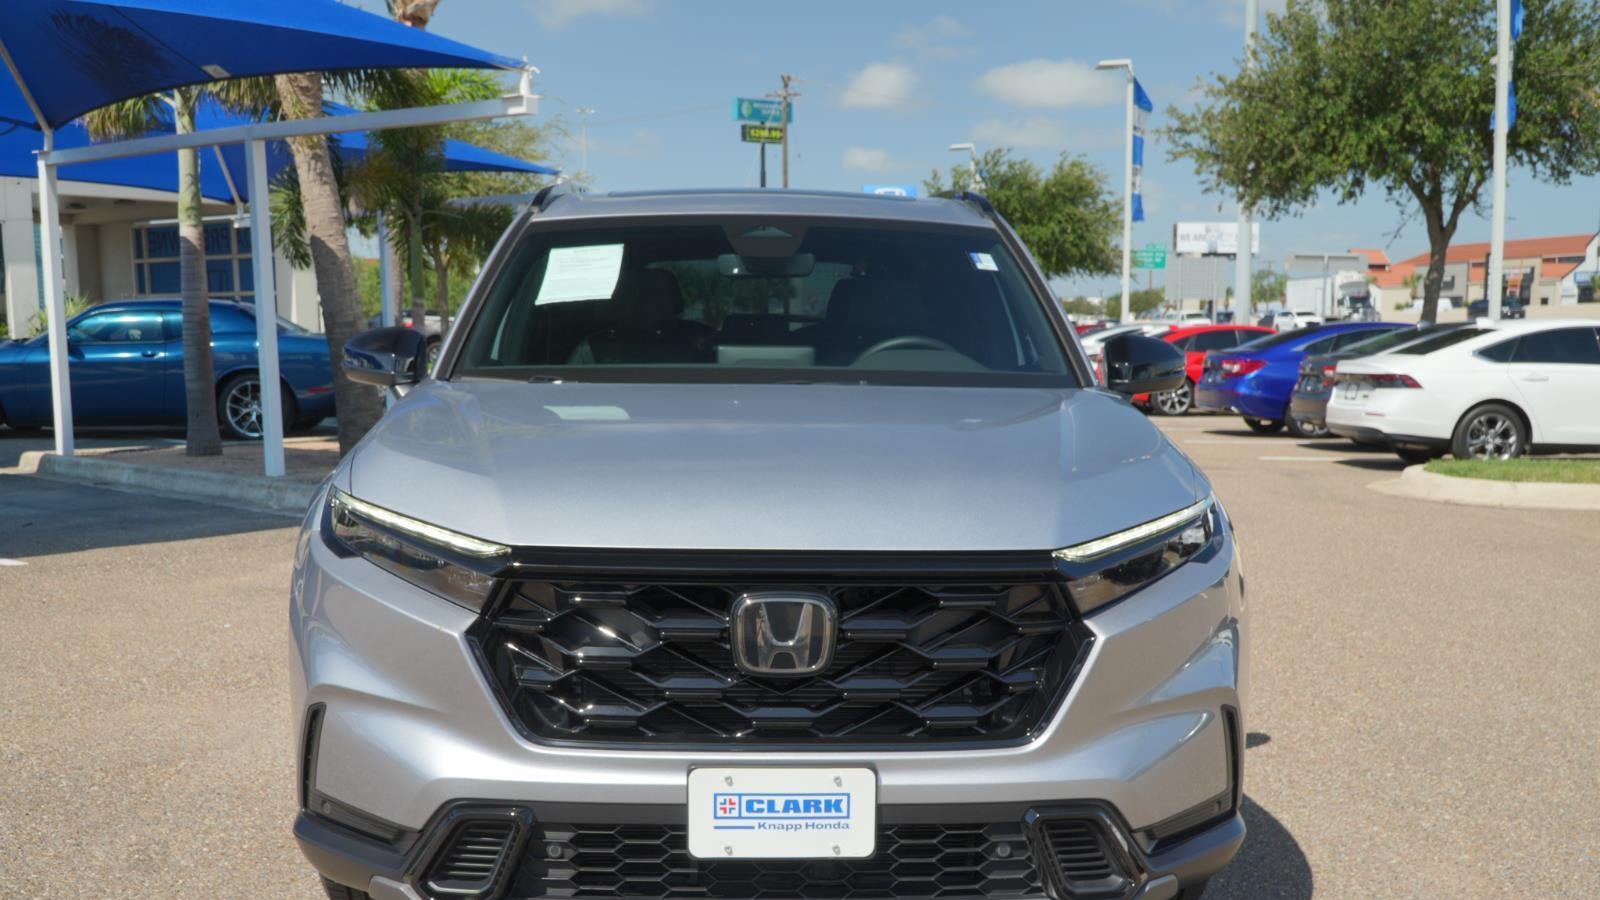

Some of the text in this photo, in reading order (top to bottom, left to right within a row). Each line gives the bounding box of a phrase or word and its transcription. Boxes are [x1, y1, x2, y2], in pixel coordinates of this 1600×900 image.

[746, 799, 842, 813] CLARK
[757, 821, 849, 832] Knapp Honda
